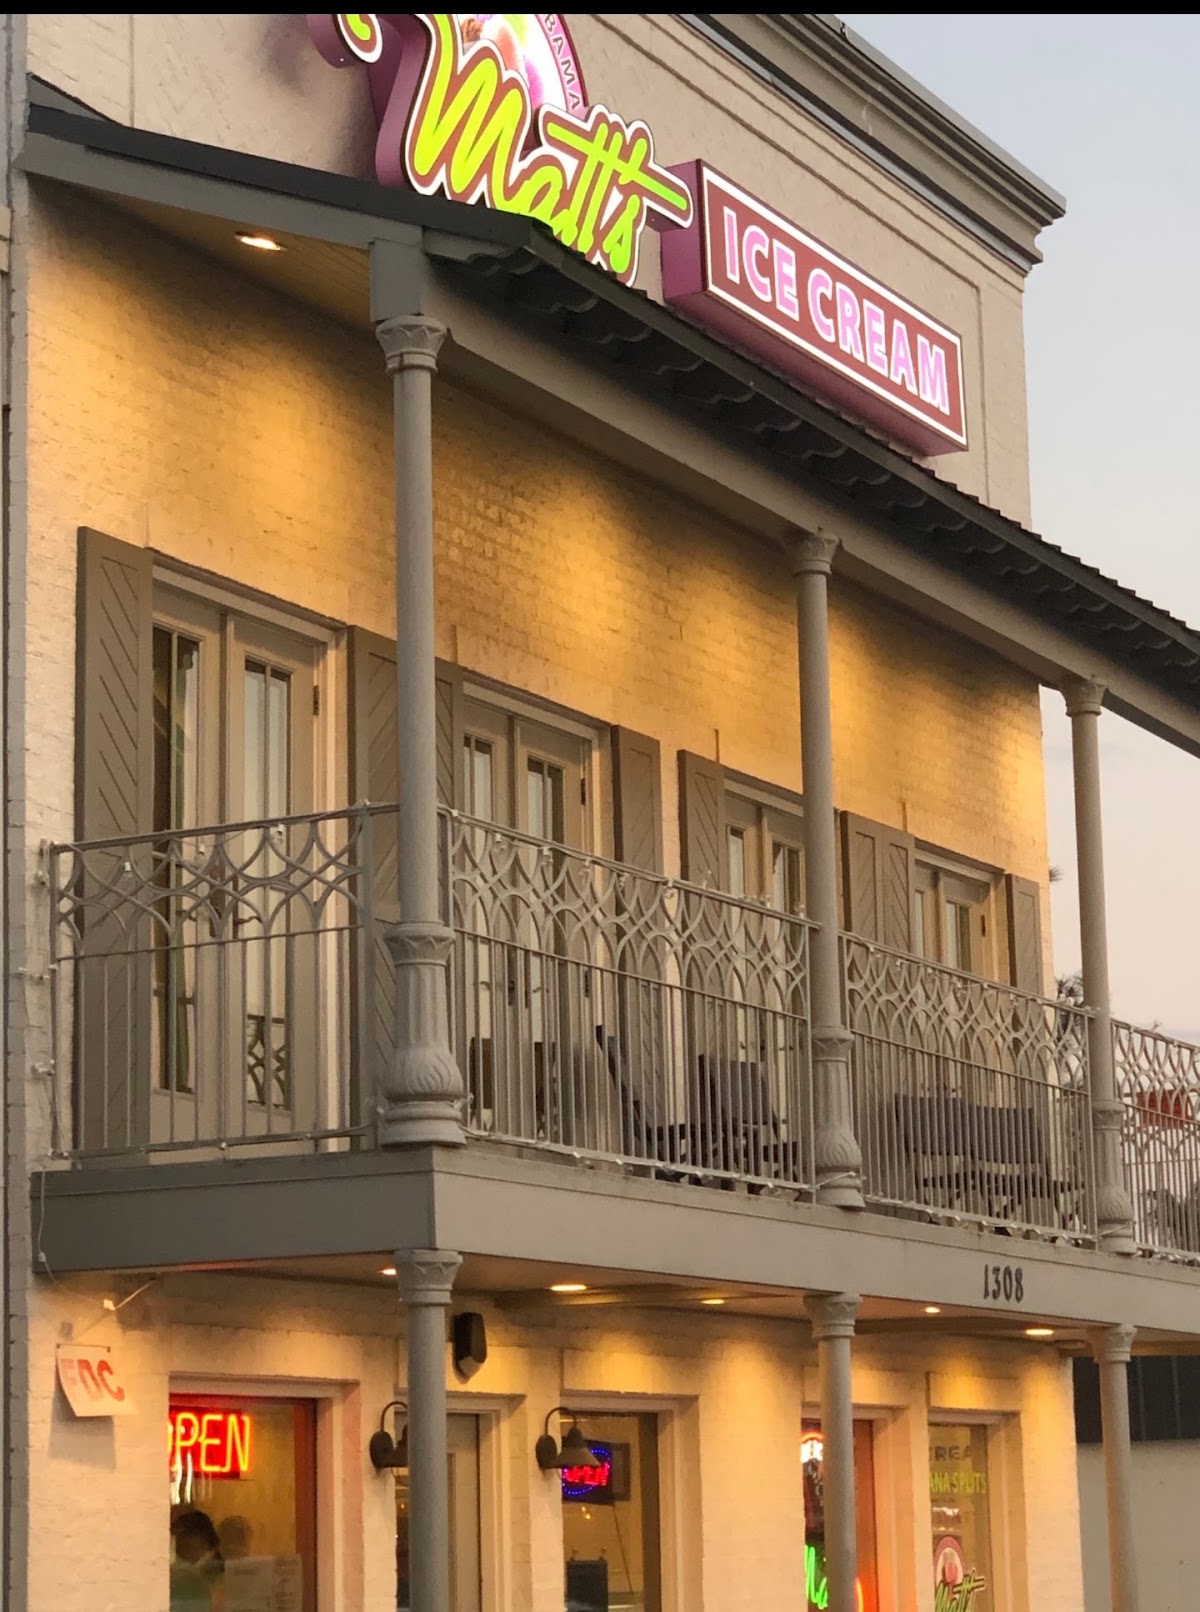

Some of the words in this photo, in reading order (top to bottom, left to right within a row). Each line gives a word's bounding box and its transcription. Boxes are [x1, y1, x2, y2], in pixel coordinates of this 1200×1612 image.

[723, 206, 799, 322] ICE
[807, 268, 950, 416] CREAM
[984, 1264, 1024, 1303] 1308
